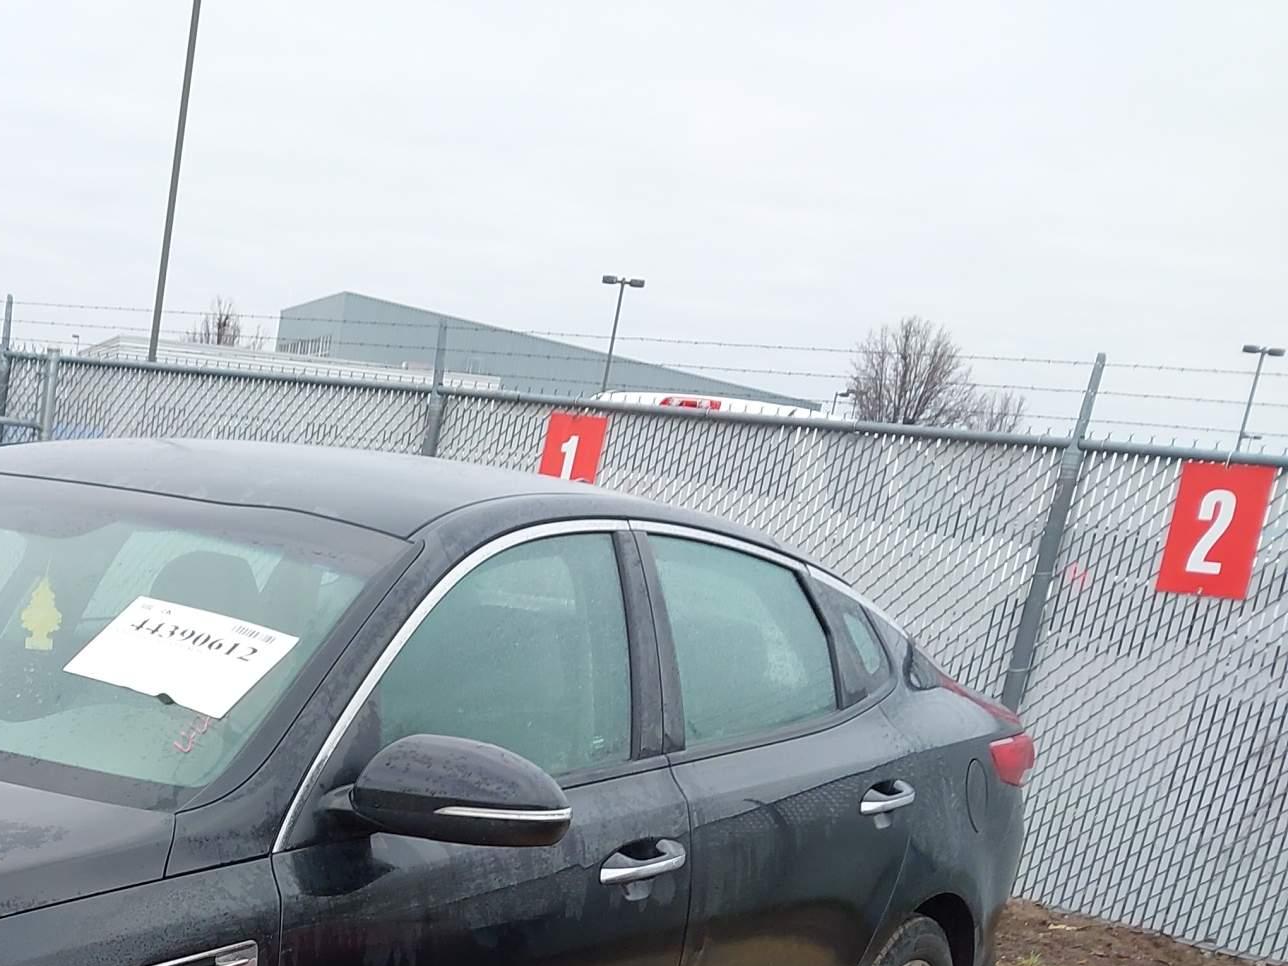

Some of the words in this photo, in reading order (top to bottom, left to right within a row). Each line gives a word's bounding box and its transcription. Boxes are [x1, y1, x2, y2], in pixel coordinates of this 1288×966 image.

[560, 434, 580, 480] 1
[1185, 488, 1237, 575] 2
[130, 616, 258, 662] 44390612
